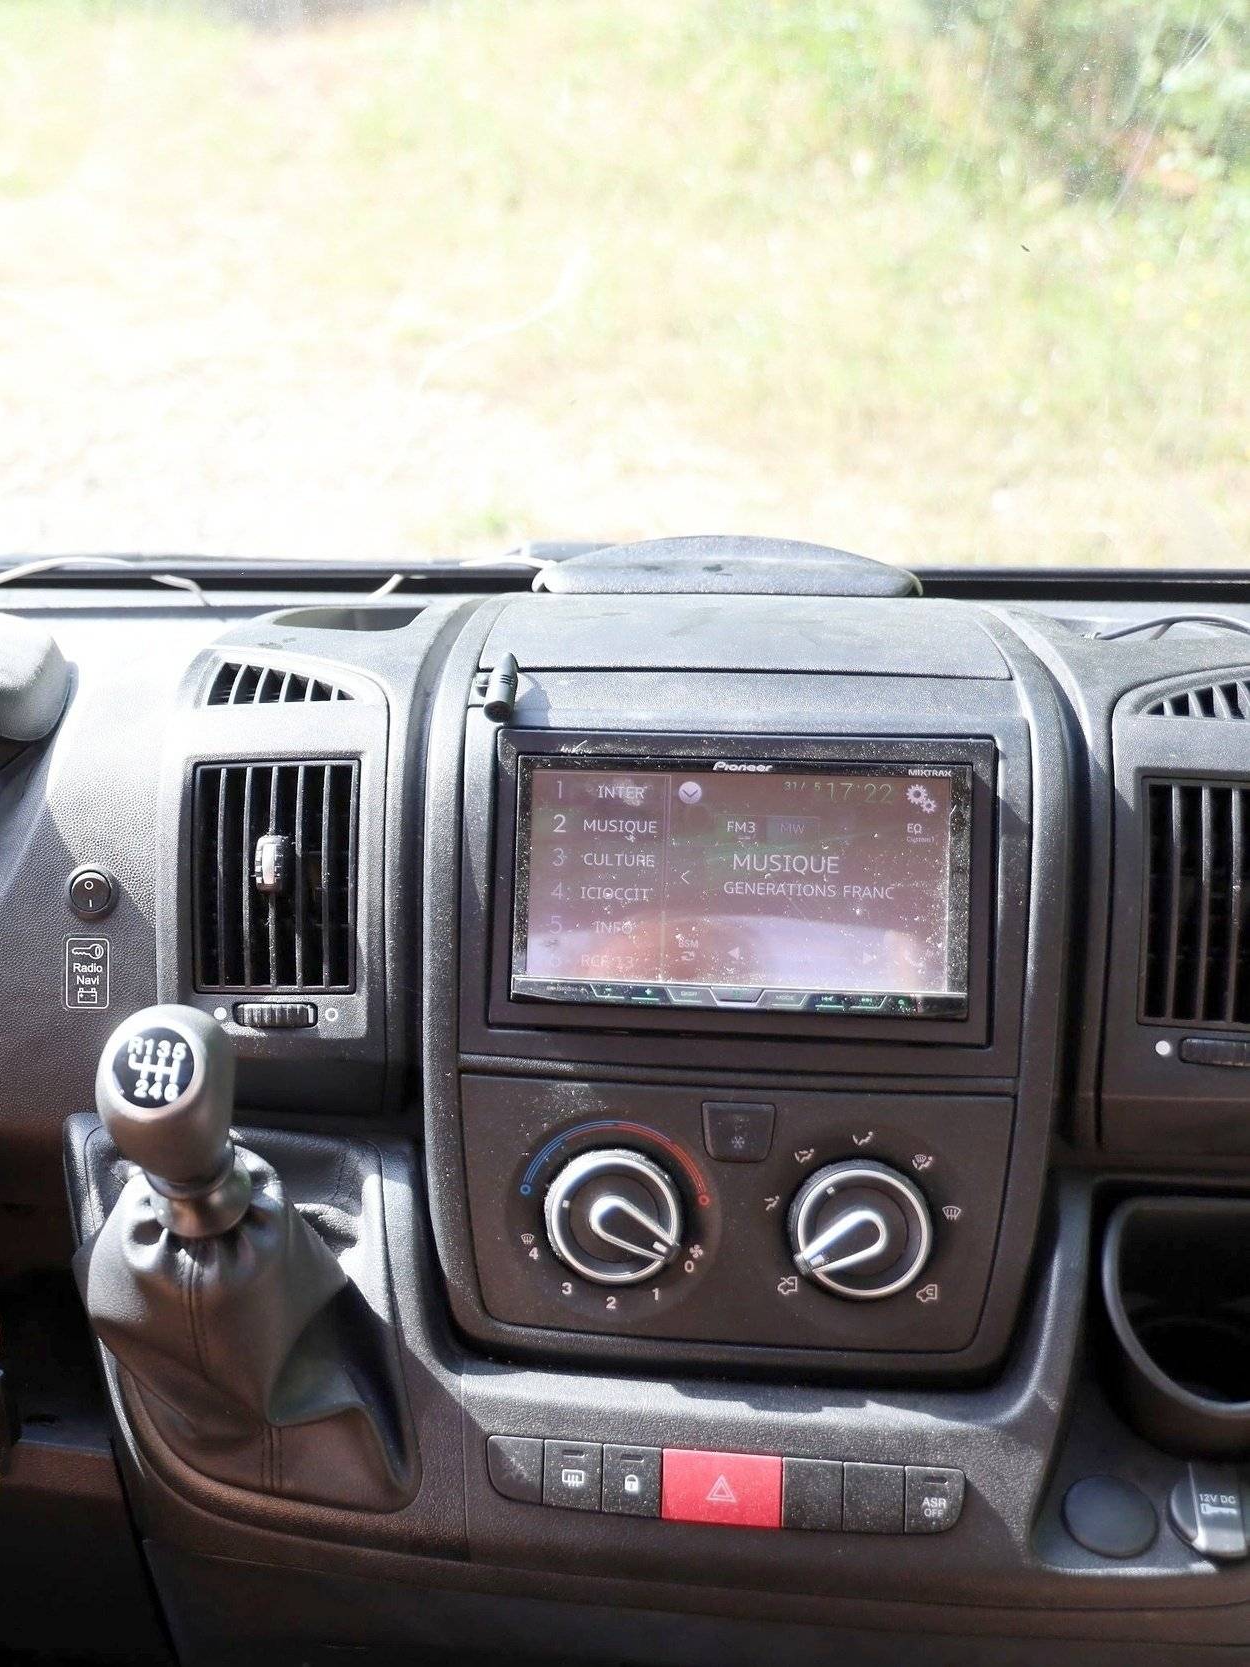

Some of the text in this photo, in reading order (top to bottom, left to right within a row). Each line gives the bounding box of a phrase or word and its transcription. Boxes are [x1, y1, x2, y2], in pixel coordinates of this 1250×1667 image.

[712, 761, 773, 773] Pioneer
[907, 768, 952, 778] MIXTRAX
[557, 780, 563, 799] 1
[597, 784, 647, 799] INTER
[552, 813, 567, 833] 2
[582, 819, 658, 834] MUSIQUE
[726, 821, 756, 834] FM3
[906, 823, 923, 836] EQ
[552, 847, 566, 867] 3
[583, 853, 656, 868] CULTURE
[732, 854, 840, 876] MUSIQUE
[723, 882, 895, 900] GENERATIONS FRANC
[73, 963, 103, 973] Radio
[76, 976, 100, 985] Navi
[528, 1247, 539, 1260] 4
[684, 1260, 695, 1273] 0
[561, 1281, 572, 1295] 3
[651, 1287, 661, 1301] 1
[605, 1296, 617, 1310] 2
[922, 1497, 947, 1508] ASR
[1220, 1494, 1236, 1504] DC
[924, 1508, 943, 1518] OFF
